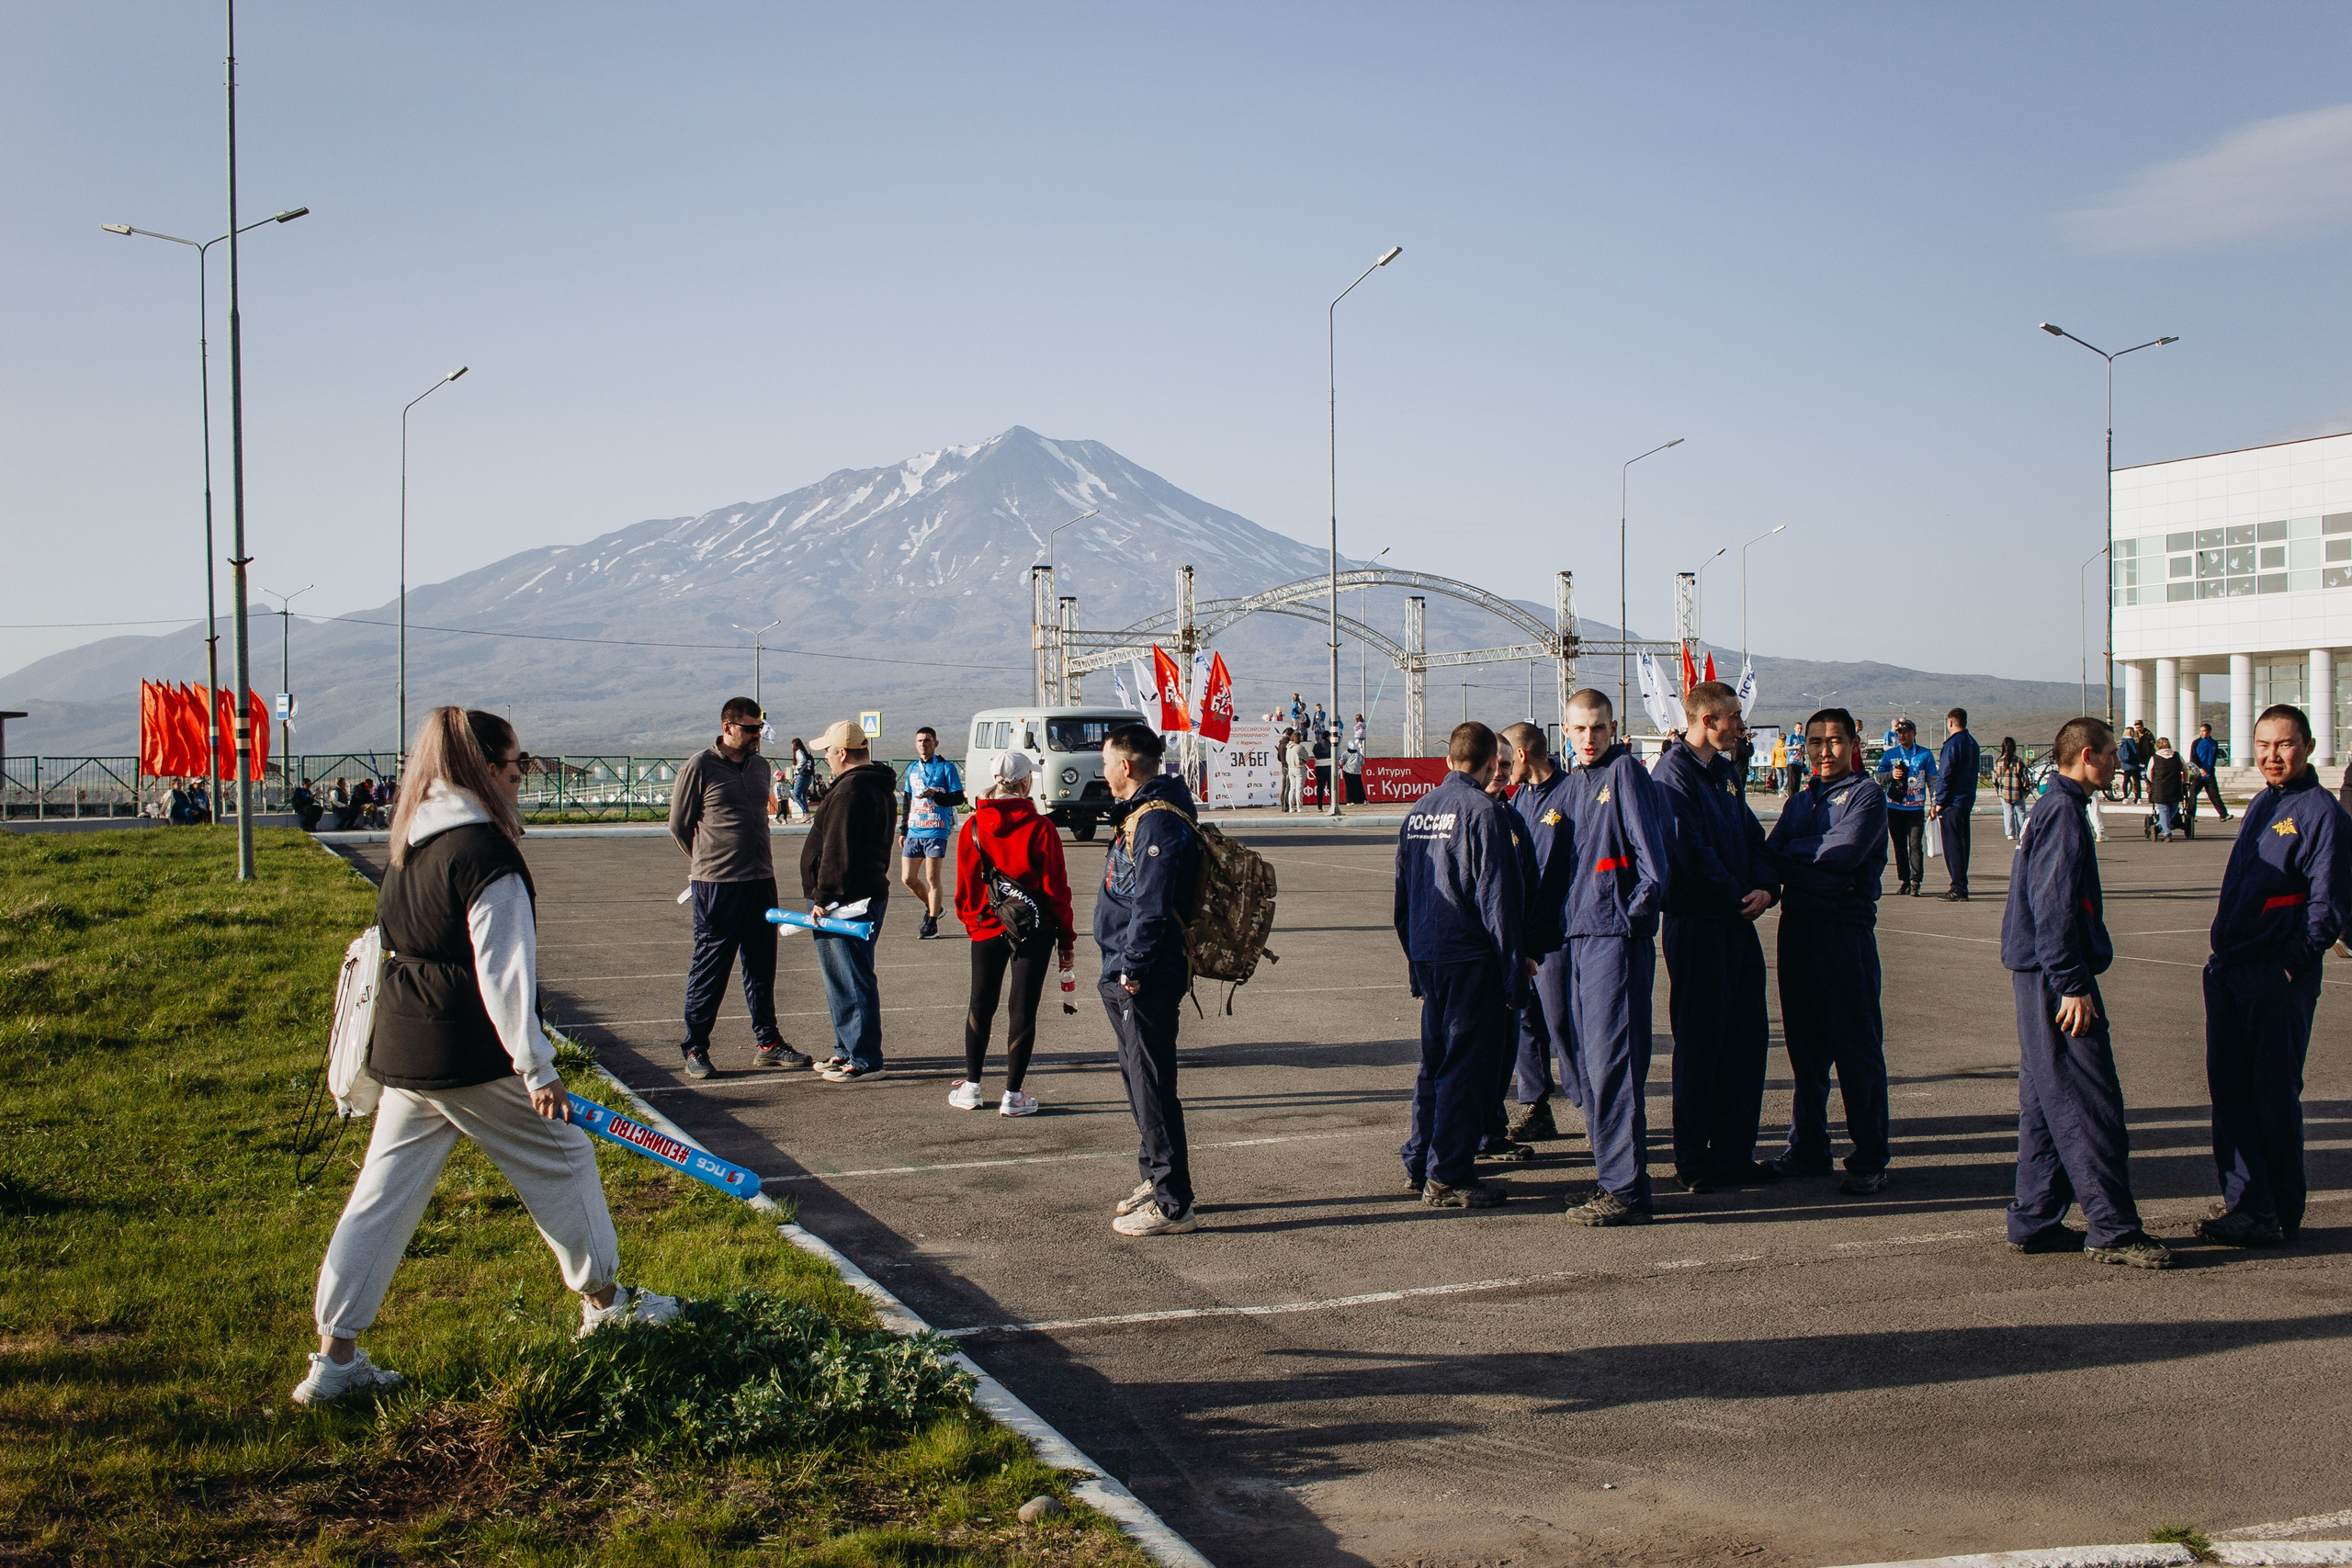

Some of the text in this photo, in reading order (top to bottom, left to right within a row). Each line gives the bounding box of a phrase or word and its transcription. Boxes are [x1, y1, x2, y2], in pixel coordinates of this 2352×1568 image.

[1378, 767, 1411, 777] Итуруп
[1367, 784, 1376, 795] г.
[1408, 813, 1456, 831] РОССИЯ
[608, 1116, 691, 1164] #ЕДИНСТВО
[695, 1156, 727, 1177] ПСБ
